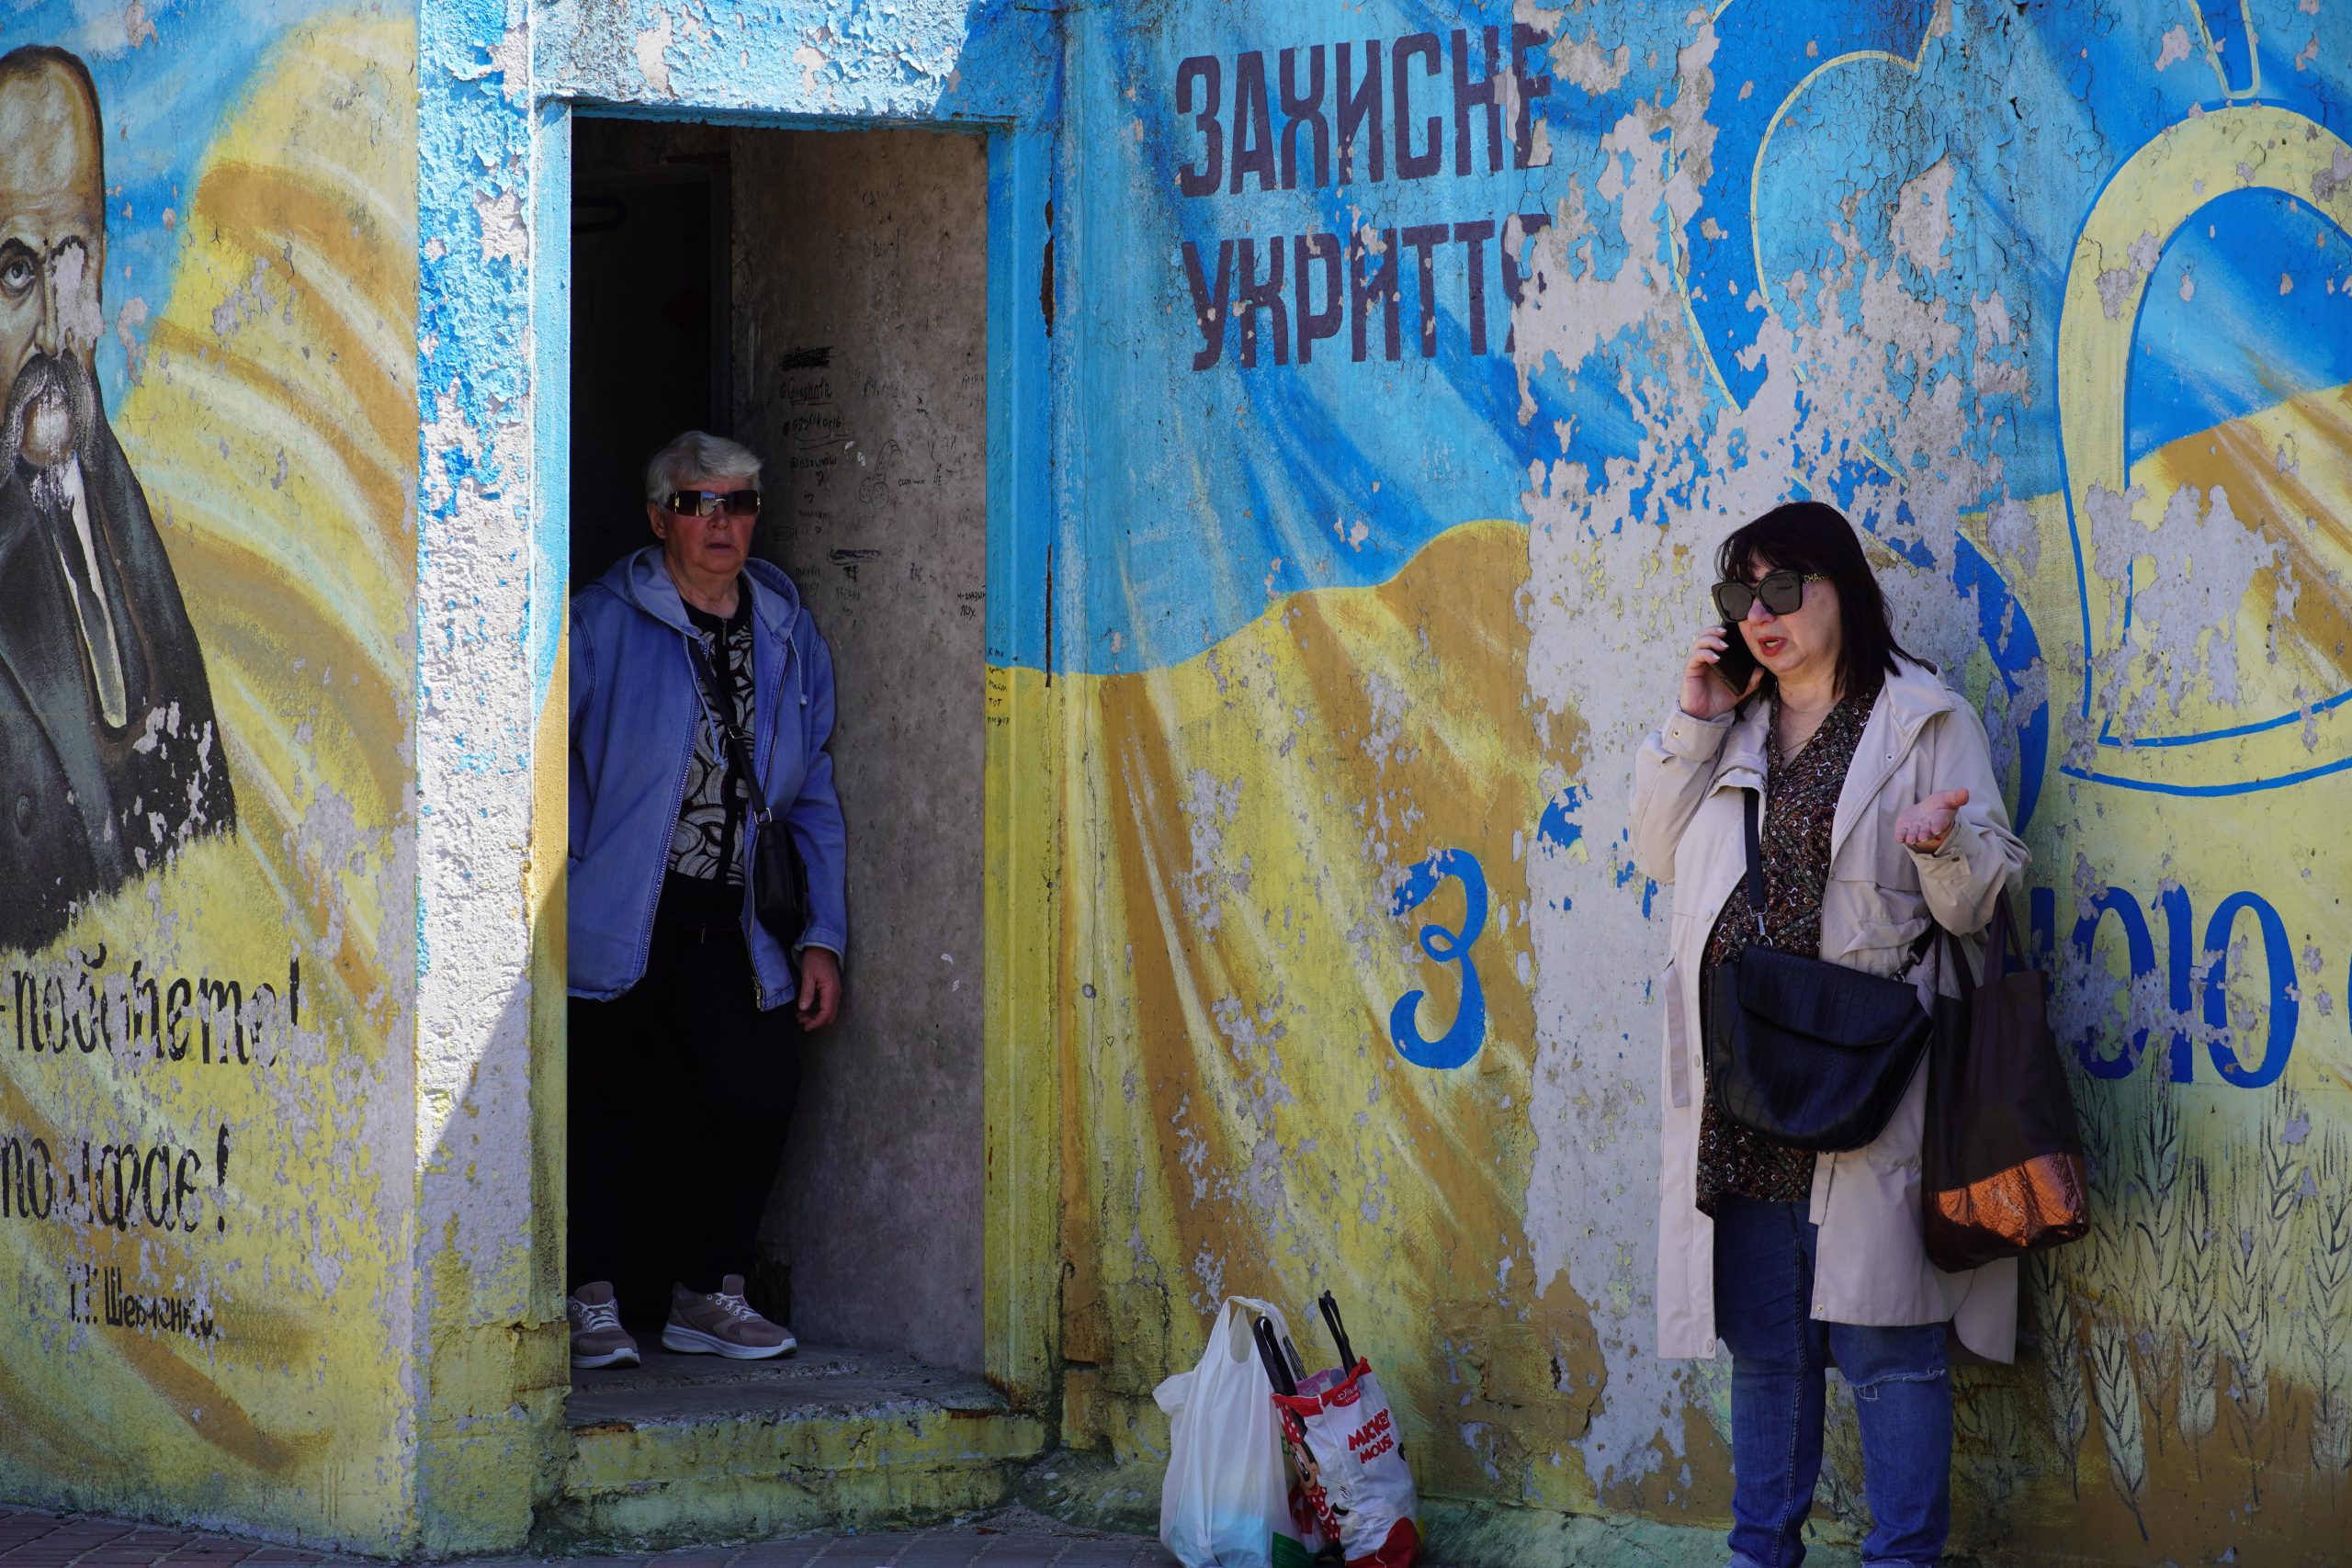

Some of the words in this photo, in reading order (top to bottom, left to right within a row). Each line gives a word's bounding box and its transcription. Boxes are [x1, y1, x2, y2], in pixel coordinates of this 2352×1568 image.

[1176, 23, 1553, 197] ЗАХИСНЕ
[1347, 1407, 1391, 1451] MICKEY
[1359, 1433, 1395, 1464] MOUS
